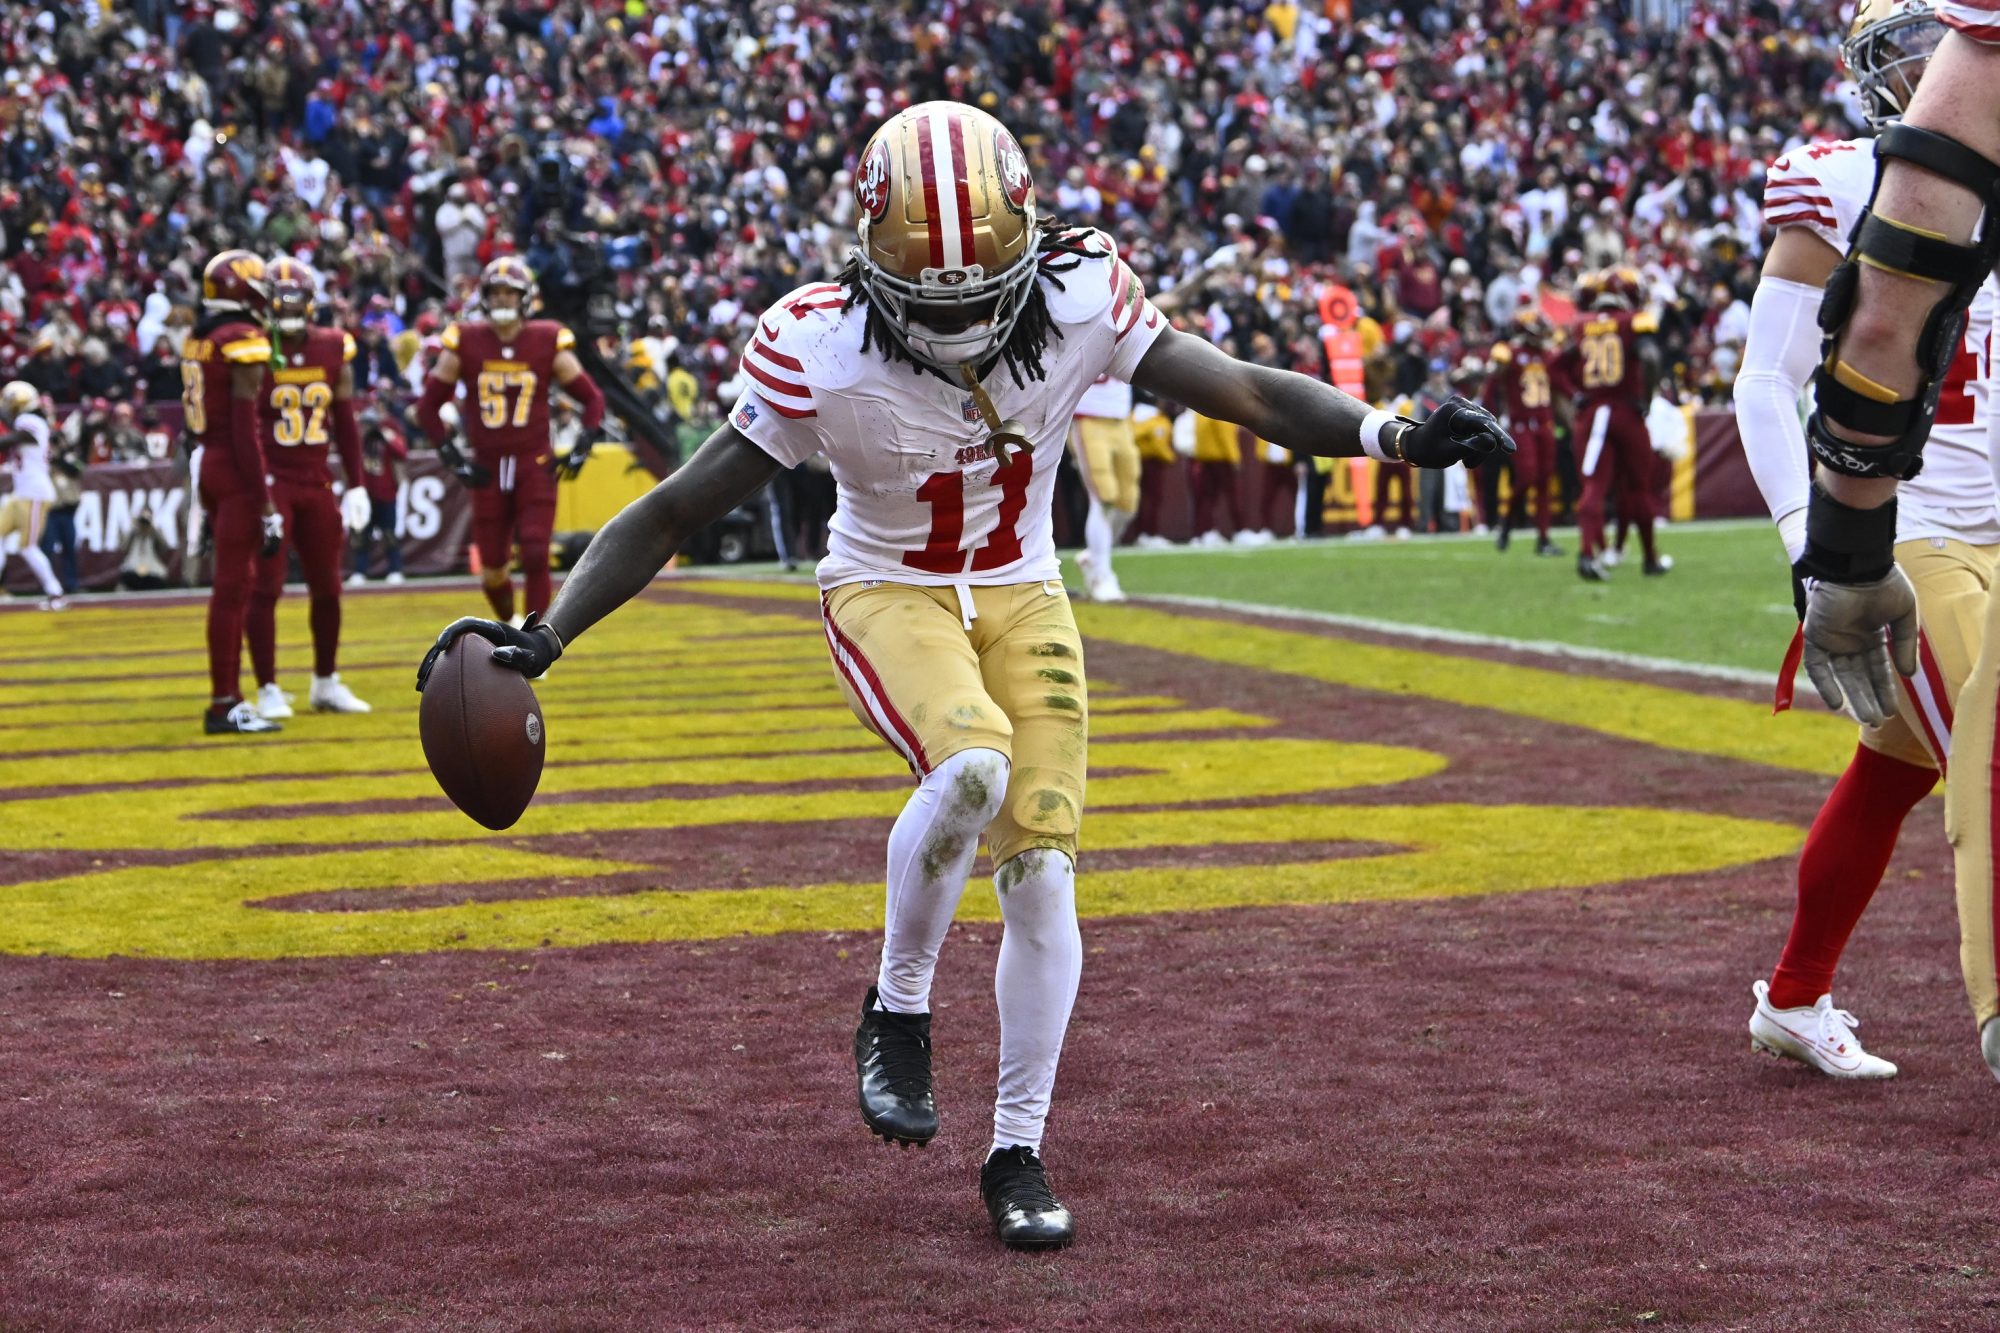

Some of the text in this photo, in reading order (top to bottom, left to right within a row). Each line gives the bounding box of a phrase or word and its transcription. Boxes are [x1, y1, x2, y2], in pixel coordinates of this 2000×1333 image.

[1581, 332, 1624, 389] 20
[270, 381, 333, 446] 32
[478, 371, 538, 428] 57
[73, 488, 184, 552] ANK
[901, 449, 1034, 574] 11
